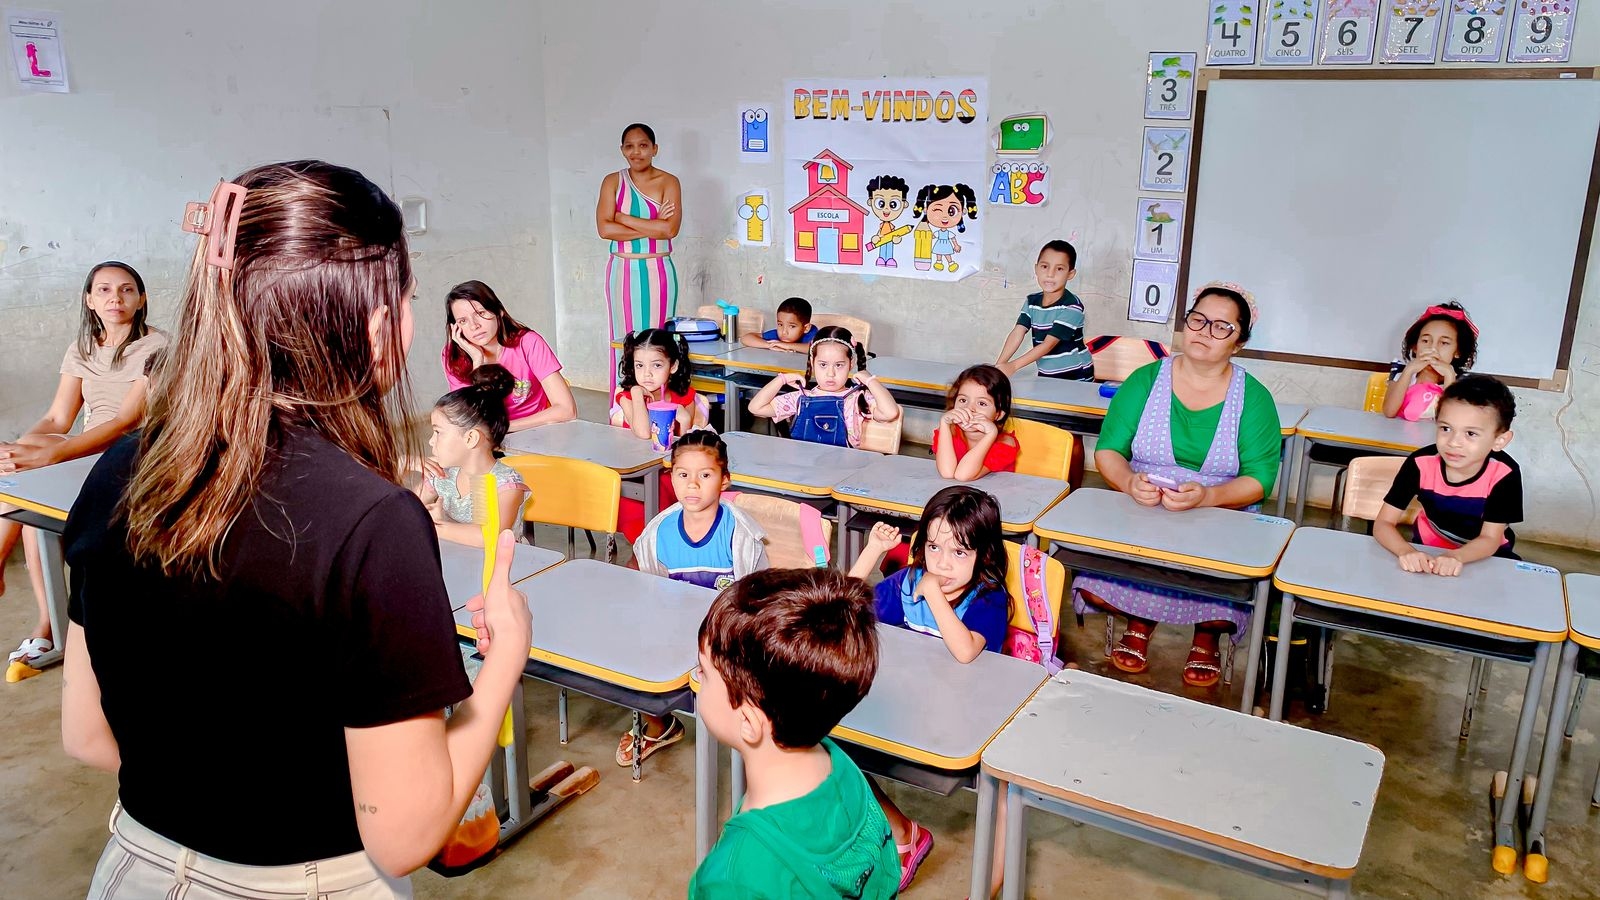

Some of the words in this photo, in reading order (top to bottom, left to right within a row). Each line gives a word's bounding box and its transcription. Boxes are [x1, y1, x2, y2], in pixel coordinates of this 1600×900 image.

[1221, 22, 1241, 47] 4
[1281, 22, 1300, 47] 5
[1338, 20, 1357, 46] 6
[1404, 17, 1423, 44] 7
[1464, 17, 1485, 44] 8
[1530, 15, 1552, 43] 9
[1213, 49, 1246, 57] QUATRO
[1275, 48, 1302, 57] CINCO
[1337, 48, 1354, 56] SEIS
[1398, 45, 1418, 54] SETE
[1461, 45, 1483, 54] OITO
[1525, 45, 1552, 54] NOVE
[1161, 78, 1177, 102] 3
[793, 88, 977, 124] BEM-VINDOS
[1159, 103, 1176, 111] TRÊS
[1156, 152, 1173, 176] 2
[989, 168, 1045, 205] ABC
[1154, 177, 1172, 185] DOIS
[1150, 223, 1163, 246] 1
[1150, 246, 1163, 254] UM
[1145, 284, 1160, 307] 0
[1142, 307, 1161, 315] ZERO
